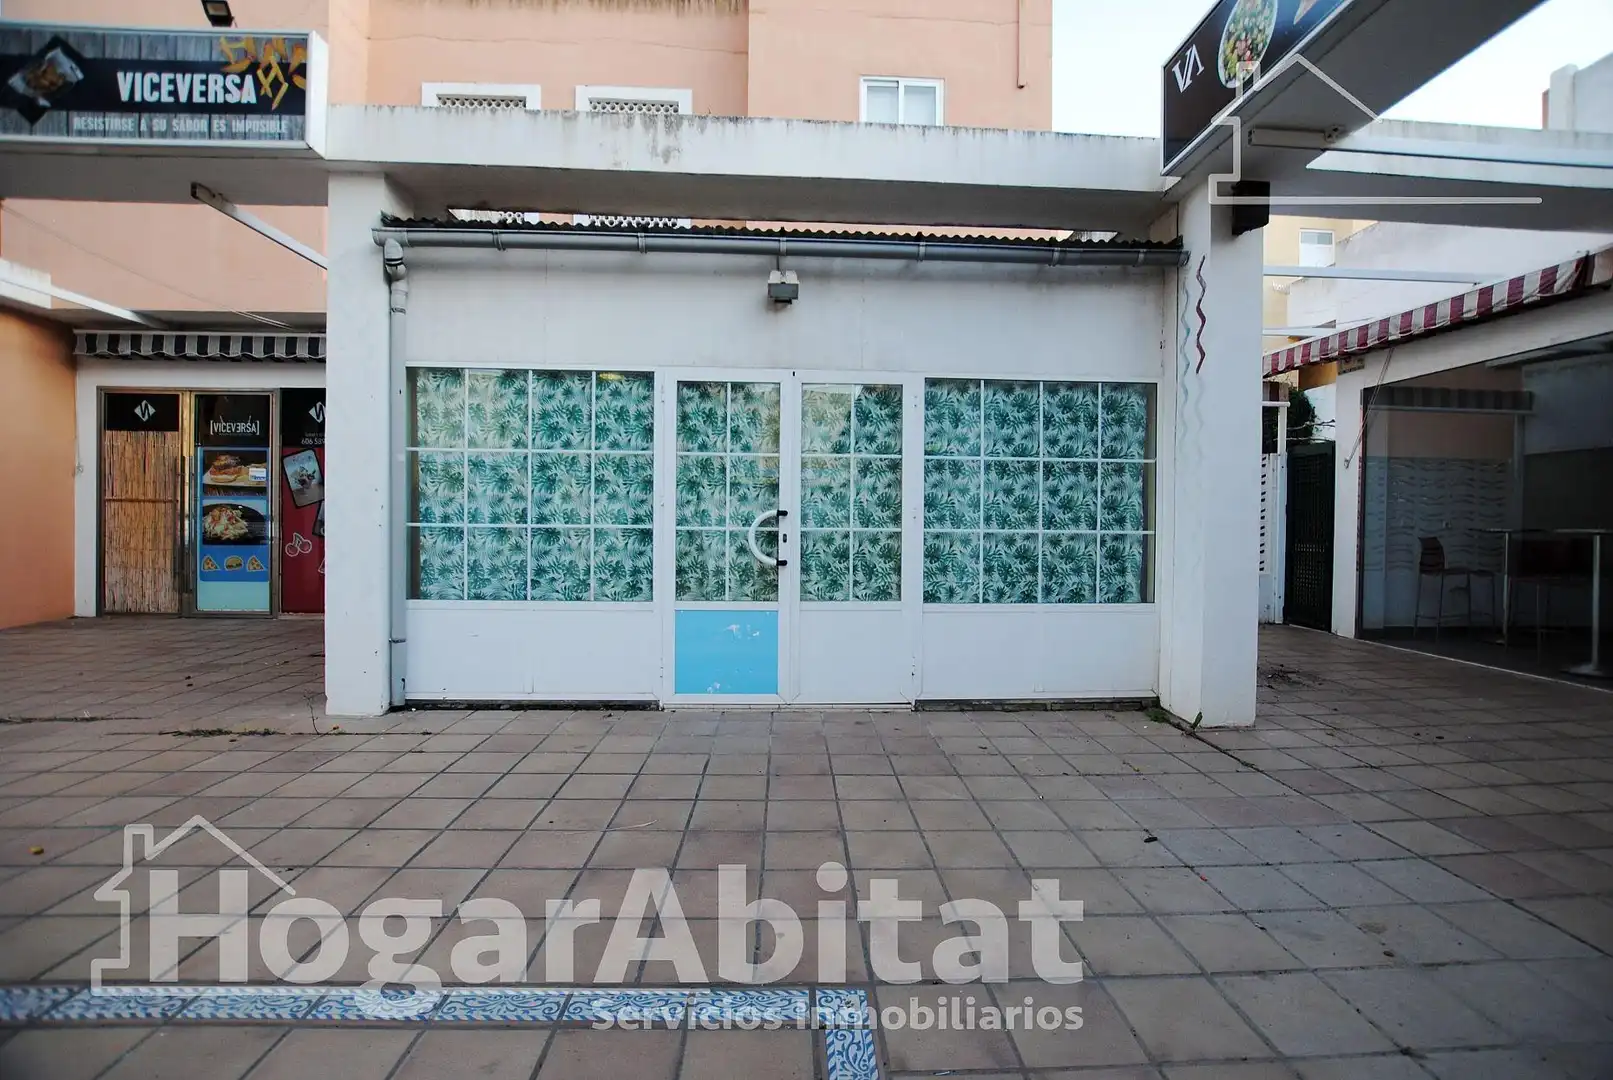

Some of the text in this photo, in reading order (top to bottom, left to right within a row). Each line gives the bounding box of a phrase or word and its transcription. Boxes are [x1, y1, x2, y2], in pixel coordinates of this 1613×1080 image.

[117, 71, 257, 104] VICEVERSA
[73, 117, 288, 133] RESISTIRSE A SU SABOR ES IMPOSIBLE
